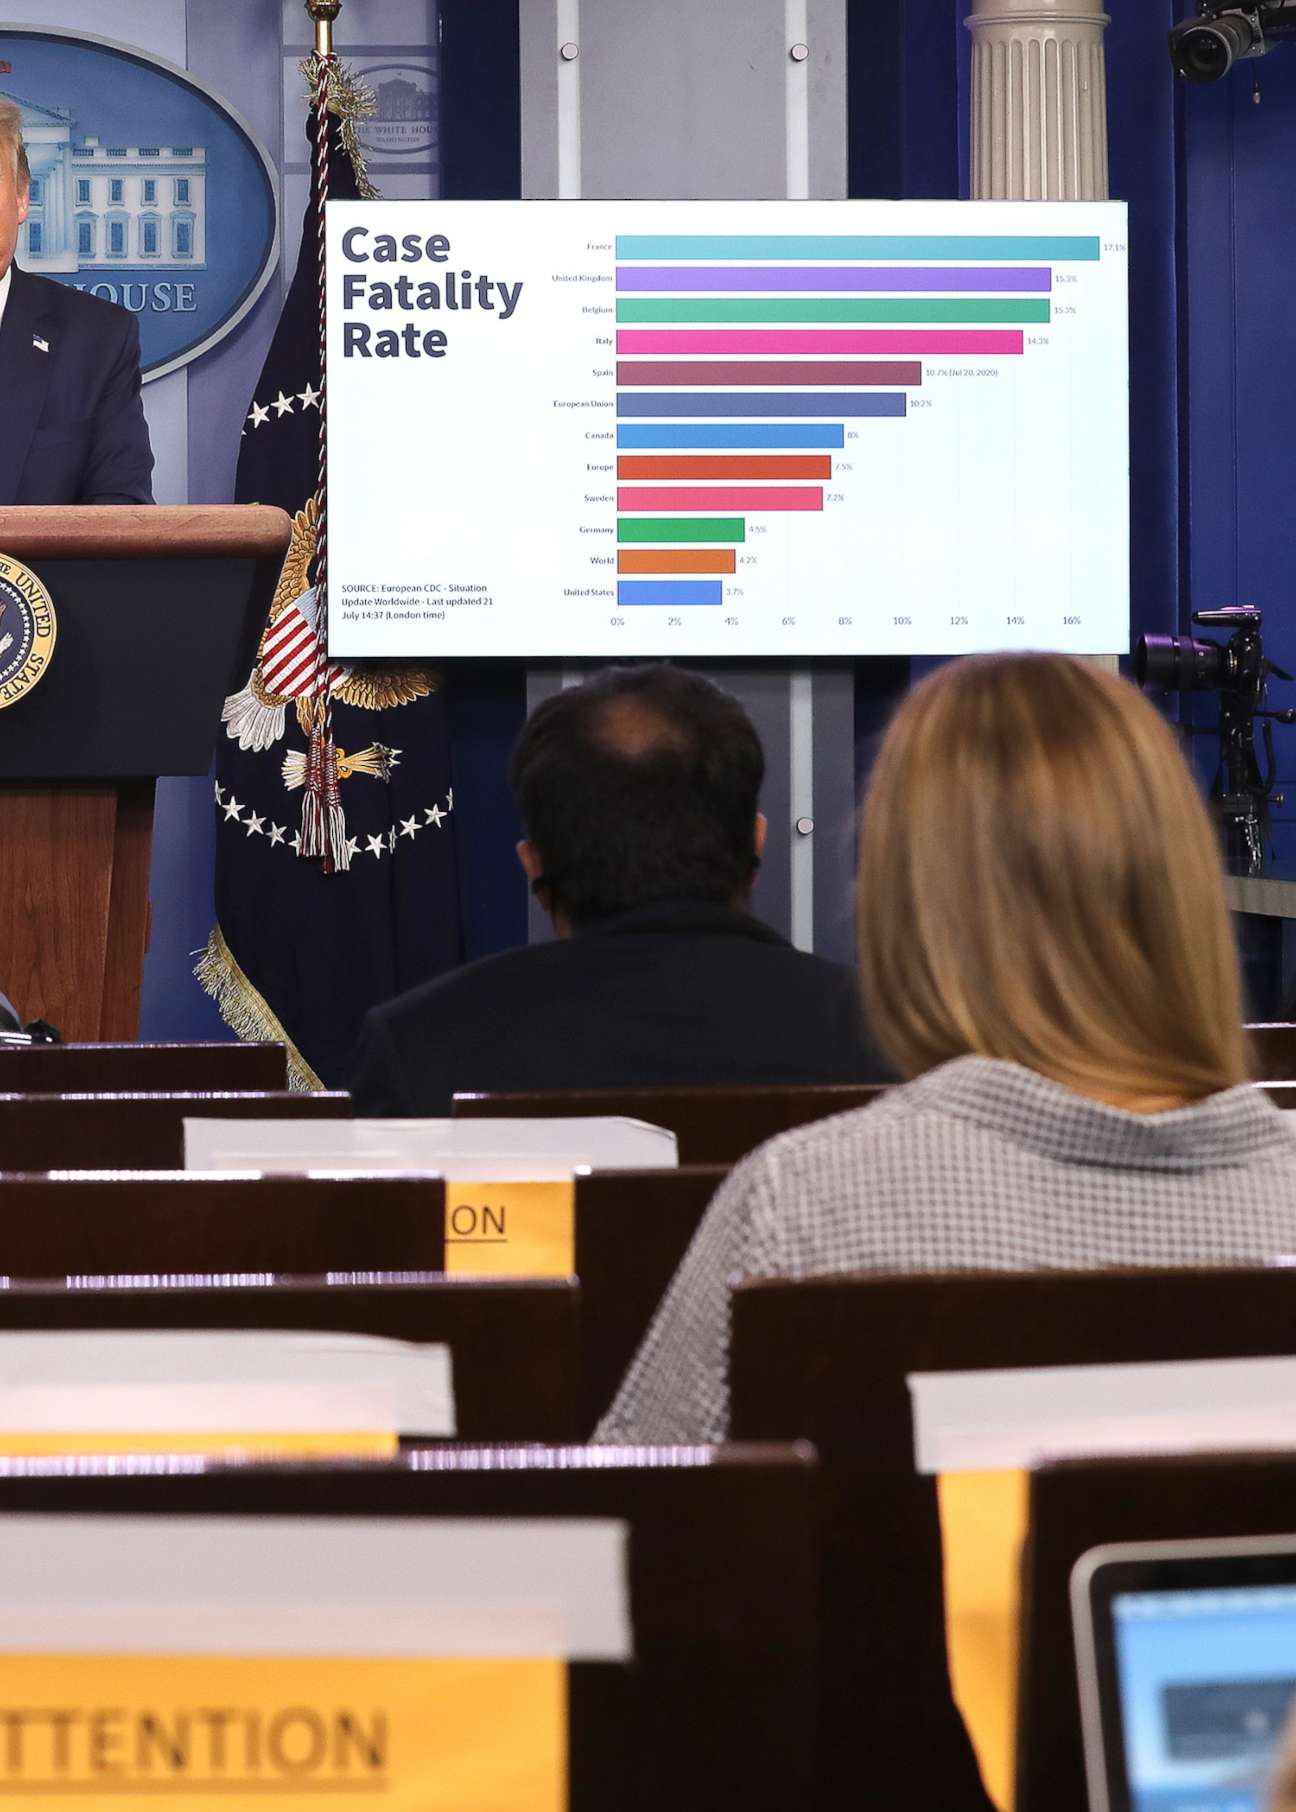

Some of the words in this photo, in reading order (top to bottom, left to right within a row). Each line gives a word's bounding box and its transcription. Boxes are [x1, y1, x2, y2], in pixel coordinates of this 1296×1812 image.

[375, 126, 407, 134] WHITE
[341, 227, 451, 262] Case
[586, 243, 612, 251] France
[1103, 244, 1126, 252] 17.1%
[551, 274, 577, 282] United
[578, 274, 613, 283] Kingdom
[65, 283, 197, 312] OUSE
[343, 270, 523, 320] Fatality
[582, 305, 613, 315] Belgium
[343, 322, 448, 357] Rate
[595, 337, 613, 346] Italy
[592, 369, 613, 378] Spain
[552, 400, 590, 409] European
[590, 400, 614, 408] Union
[586, 463, 614, 472] Europe
[584, 494, 614, 502] Sweden
[579, 526, 614, 535] Germany
[590, 557, 615, 565] World
[341, 584, 379, 593] SOURCE:
[381, 584, 422, 595] European
[423, 584, 442, 593] CDC
[448, 583, 487, 593] Situation
[563, 588, 589, 597] United
[590, 588, 615, 597] States
[15, 573, 51, 638] UNITED
[341, 597, 372, 608] Update
[374, 597, 420, 606] Worldwide
[426, 597, 443, 606] Last
[445, 597, 482, 608] updated
[483, 597, 493, 606] 21
[341, 611, 359, 621] July
[361, 611, 384, 620] 14:37
[385, 610, 421, 621] (London
[422, 610, 445, 621] time)
[610, 617, 625, 626] 0%
[667, 617, 682, 626] 2%
[724, 617, 739, 626] 4%
[781, 616, 796, 626] 6%
[838, 616, 853, 626] 8%
[893, 616, 912, 625] 10%
[949, 616, 969, 625] 12%
[1006, 616, 1025, 625] 14%
[1062, 616, 1082, 625] 16%
